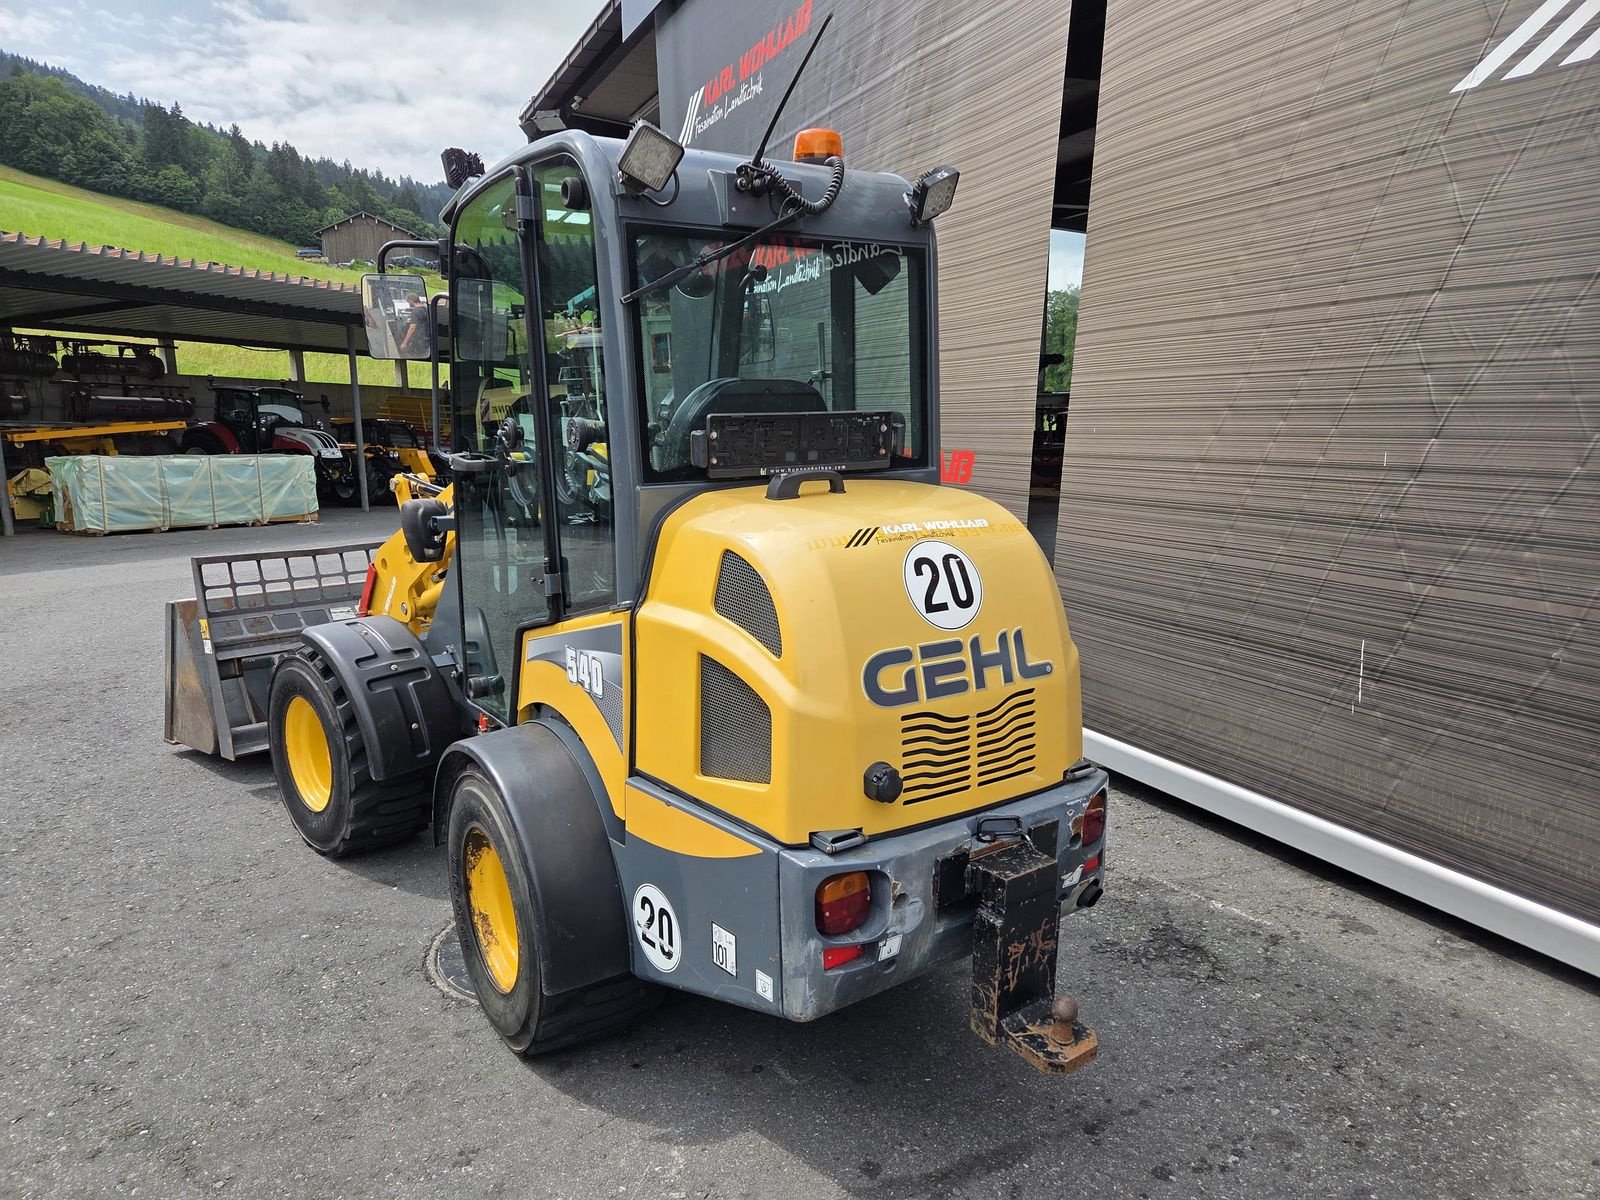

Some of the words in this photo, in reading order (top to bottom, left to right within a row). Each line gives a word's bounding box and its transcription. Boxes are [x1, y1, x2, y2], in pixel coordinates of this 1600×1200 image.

[704, 63, 735, 108] KARL
[739, 0, 812, 81] WOHLLAIB
[723, 71, 763, 119] Landtechnik
[882, 522, 922, 535] KARL
[923, 518, 989, 531] WOHLLAIB
[913, 553, 974, 614] 20
[565, 644, 603, 699] 540
[861, 625, 1053, 709] GEHL
[640, 895, 674, 961] 20
[713, 940, 728, 970] 101
